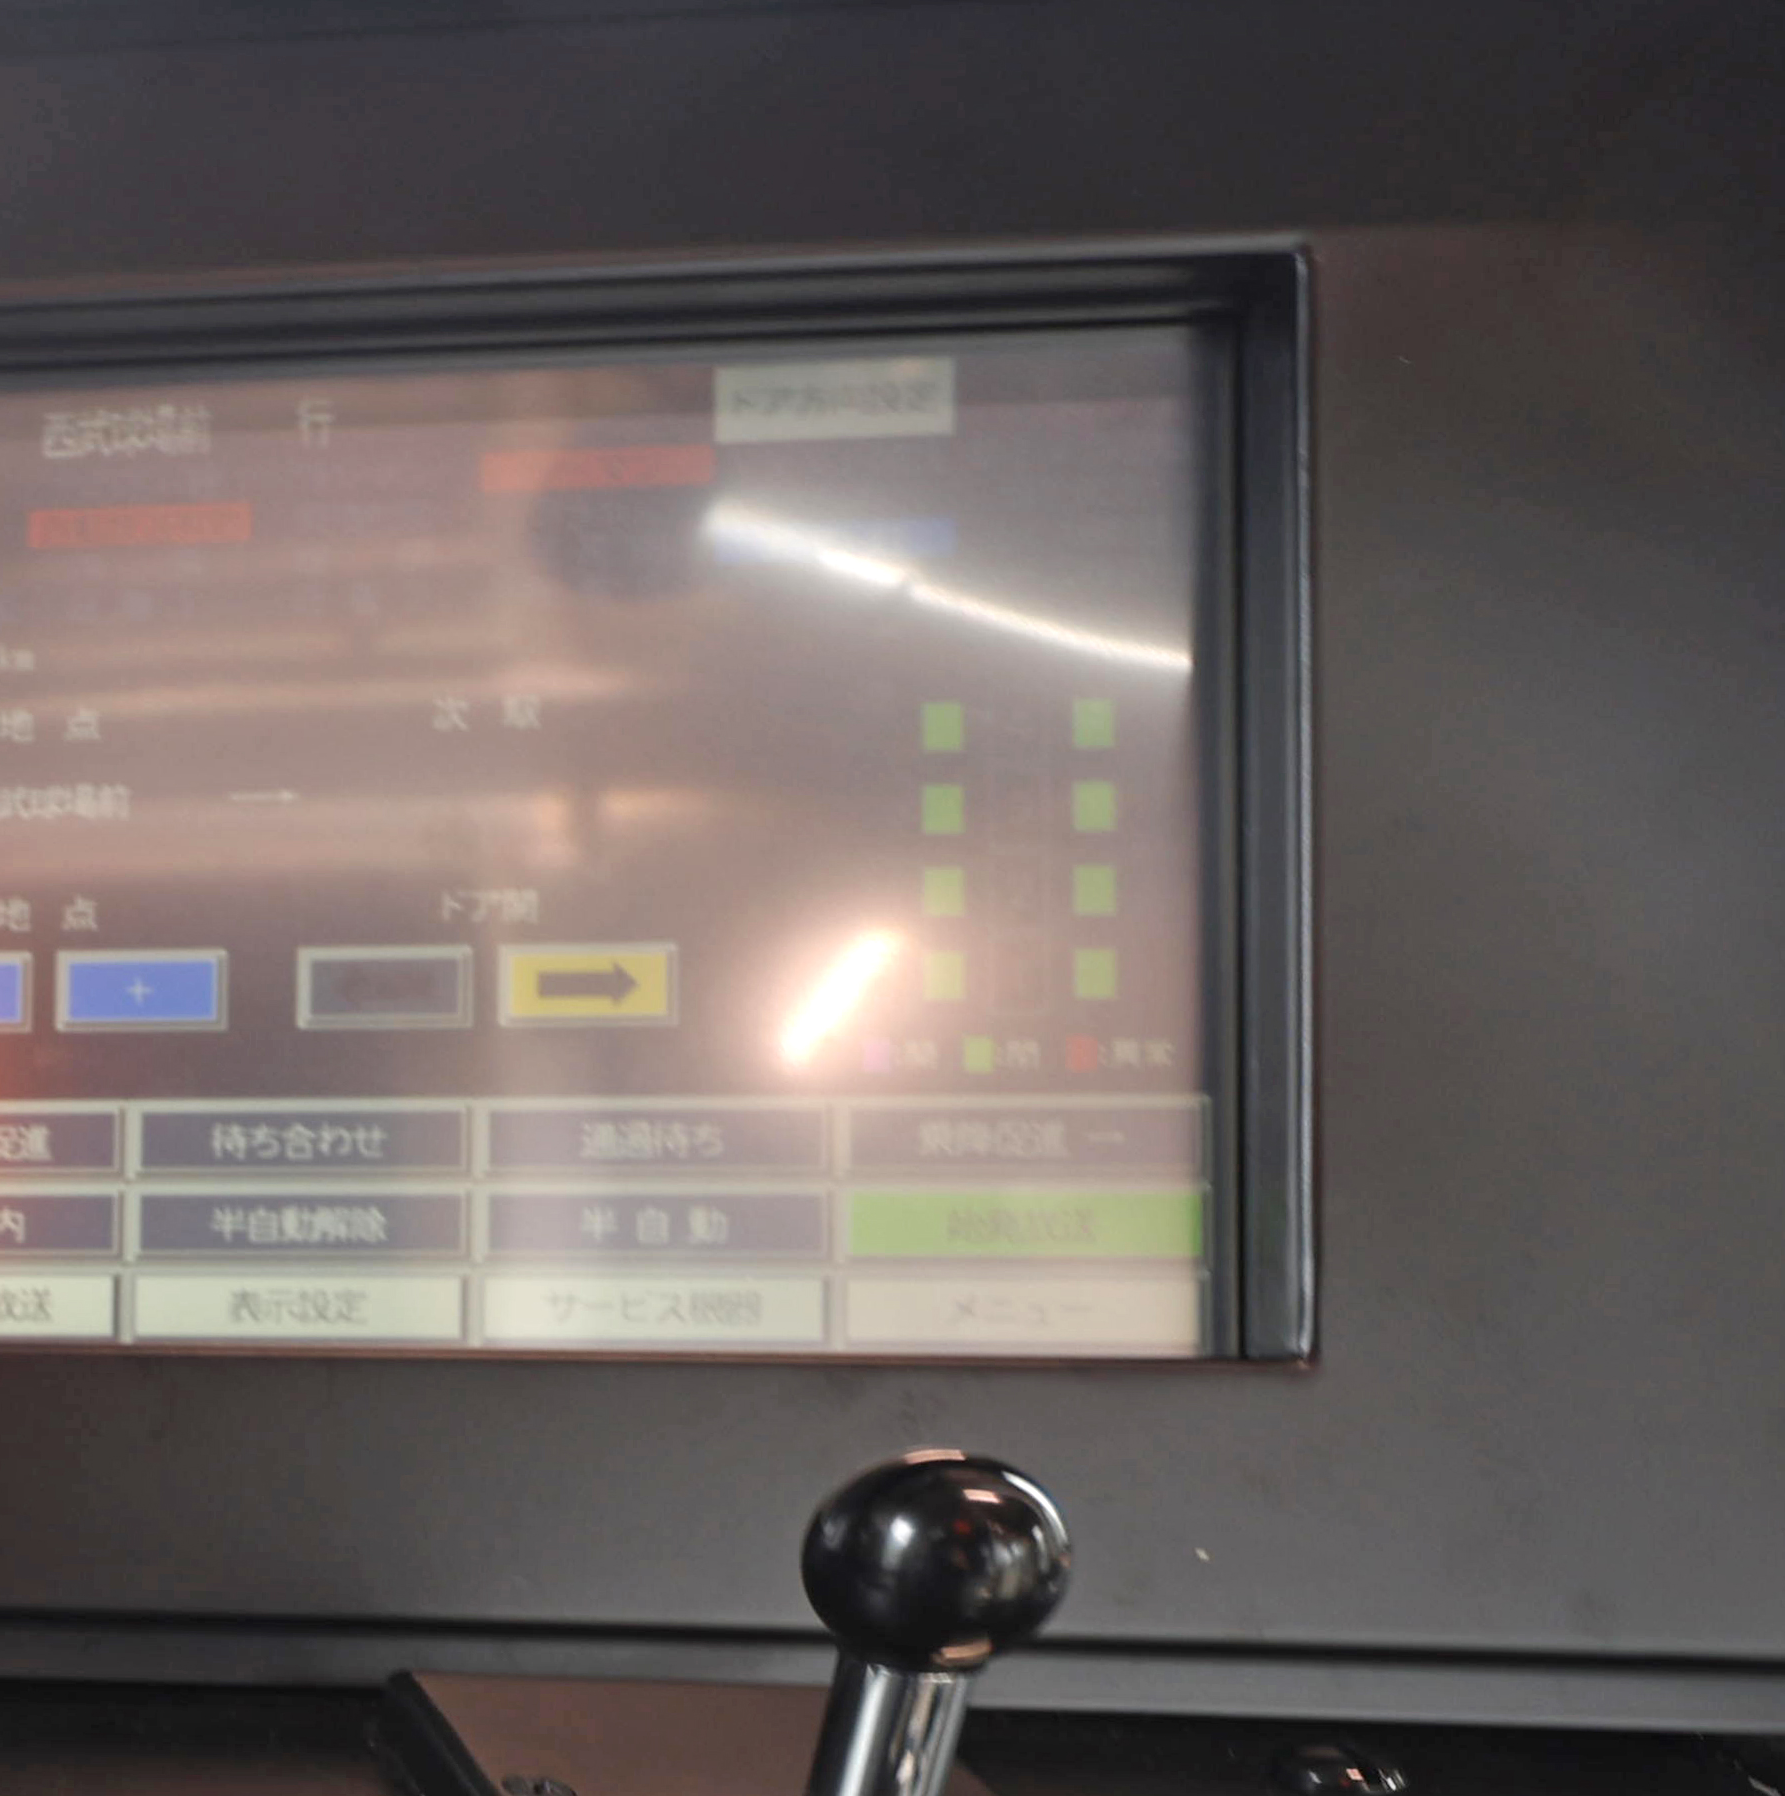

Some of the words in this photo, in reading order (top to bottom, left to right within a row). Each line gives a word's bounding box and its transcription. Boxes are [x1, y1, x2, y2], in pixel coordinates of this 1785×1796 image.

[210, 1122, 388, 1162] 待ち合わせ
[230, 1288, 368, 1325] 表示設定
